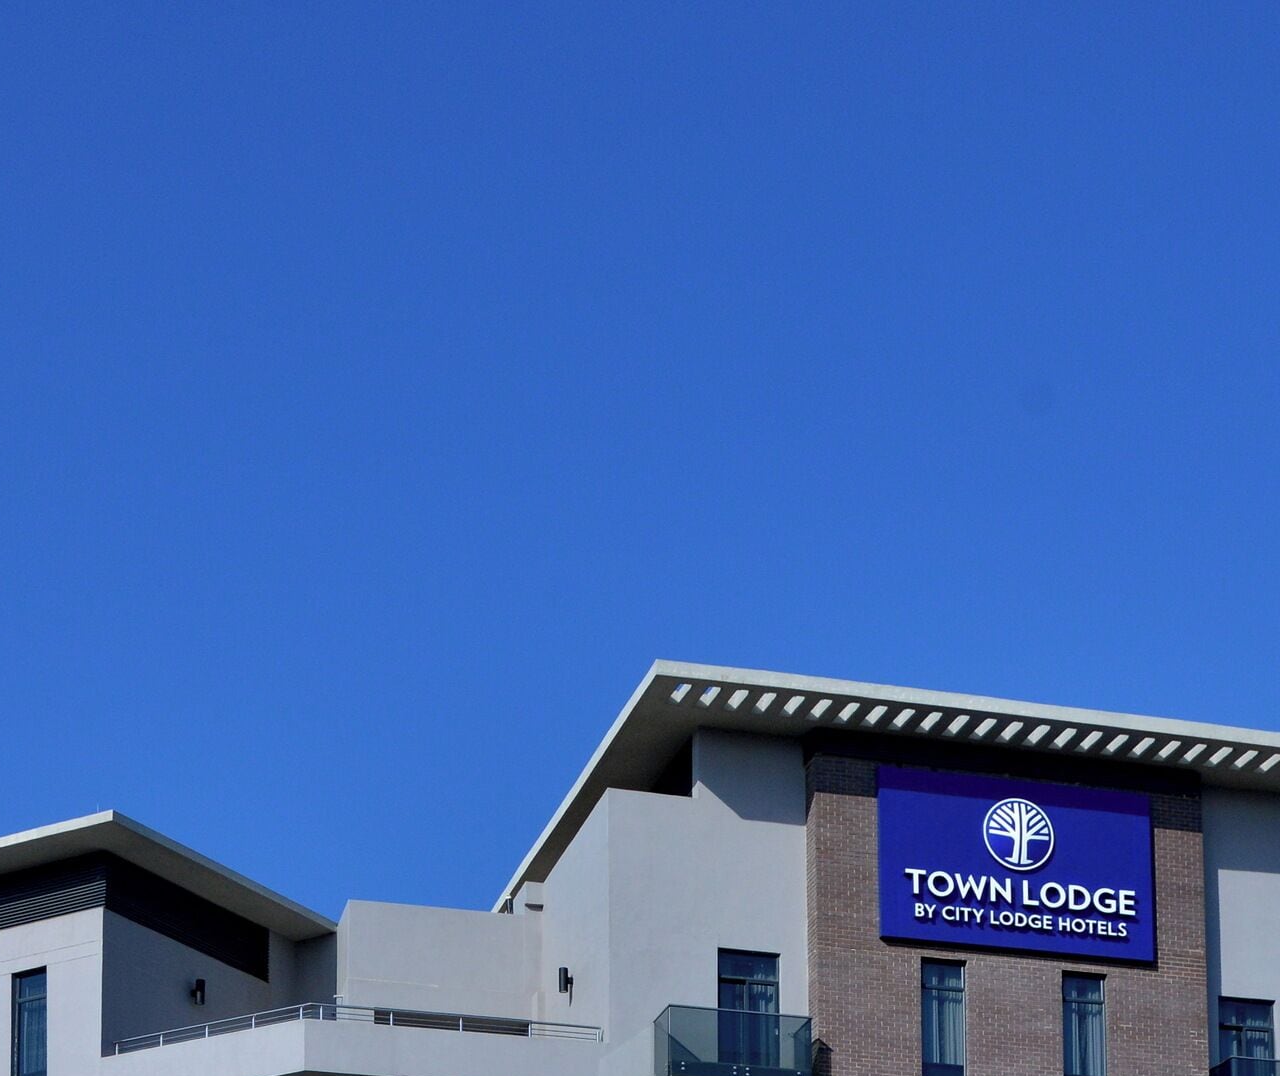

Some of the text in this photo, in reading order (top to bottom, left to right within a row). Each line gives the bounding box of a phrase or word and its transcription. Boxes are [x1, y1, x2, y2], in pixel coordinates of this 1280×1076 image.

[904, 867, 1137, 917] TOWN LODGE
[914, 902, 1128, 938] BY CITY LODGE HOTELS
